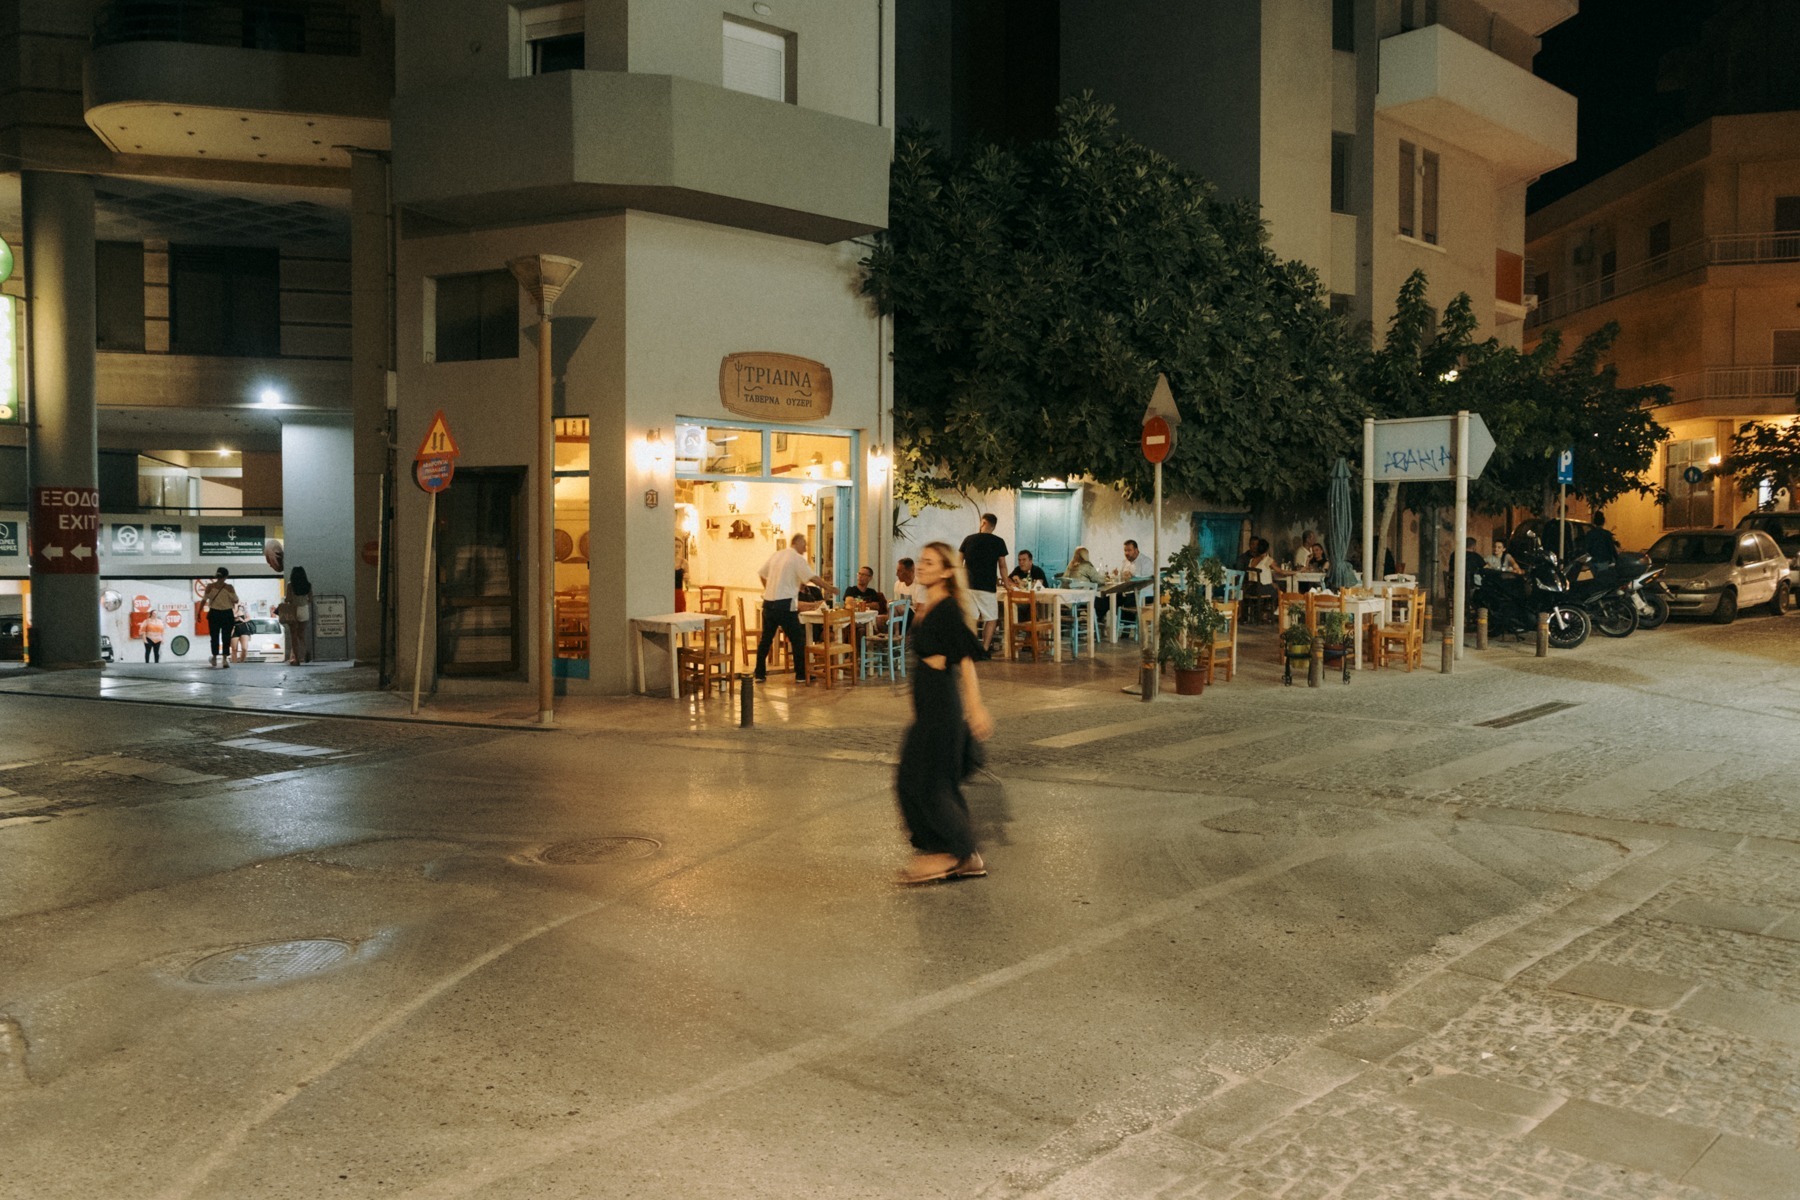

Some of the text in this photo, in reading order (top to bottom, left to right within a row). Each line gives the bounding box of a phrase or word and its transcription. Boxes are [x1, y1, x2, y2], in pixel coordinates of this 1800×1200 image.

[744, 366, 812, 388] ΤΡΙΑΙΝΑ
[744, 394, 812, 407] ΤΑΒΕΡΝΑ ΟΥΖΕΡΙ
[1561, 450, 1572, 472] P
[647, 494, 657, 504] 21
[59, 514, 97, 530] EXIT
[134, 600, 150, 608] STOP
